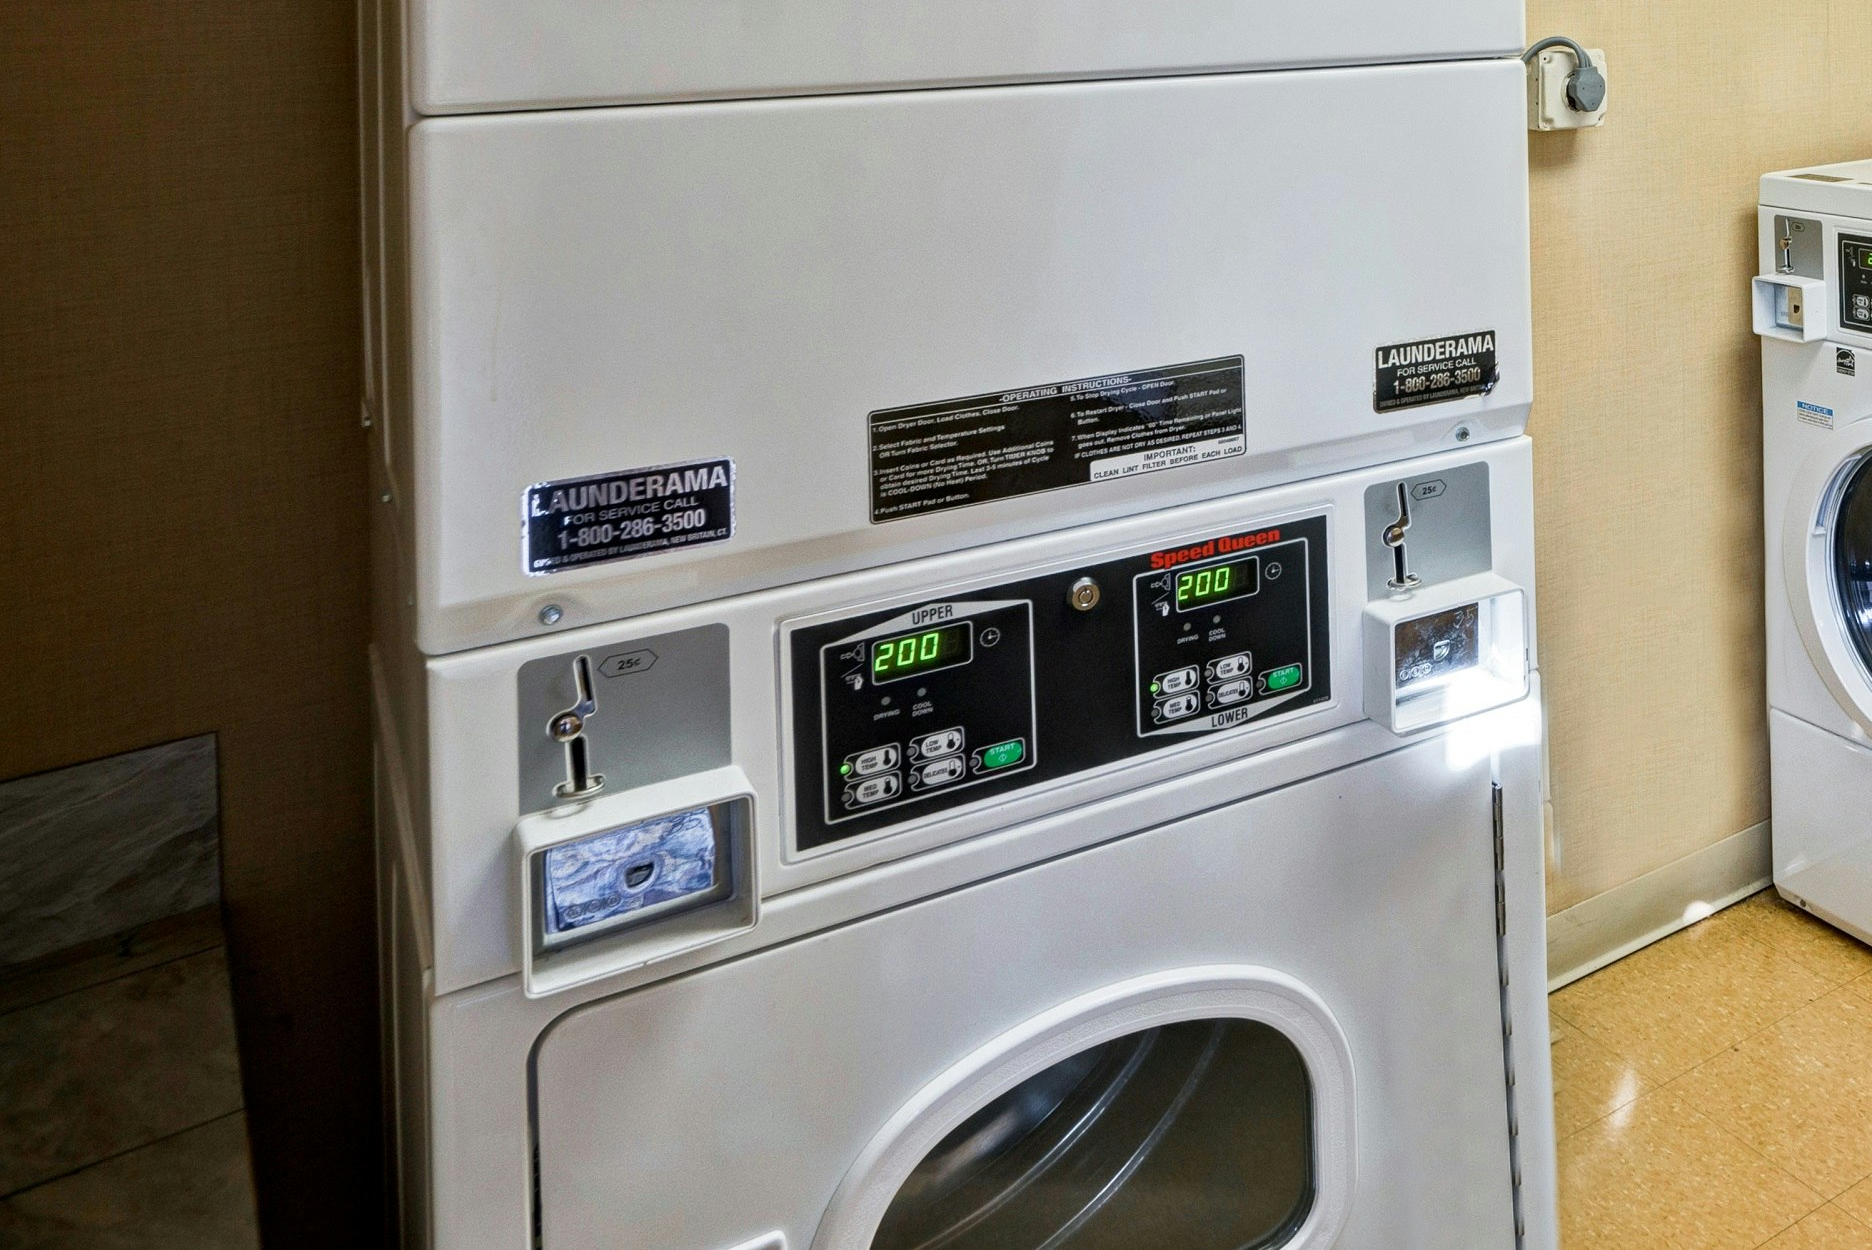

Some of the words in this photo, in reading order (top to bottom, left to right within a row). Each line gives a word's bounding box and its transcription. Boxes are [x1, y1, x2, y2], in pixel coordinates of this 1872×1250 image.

[1378, 334, 1494, 368] LAUNDERAMA
[1418, 361, 1454, 374] SERVICE
[1456, 358, 1476, 366] CALL
[1394, 367, 1480, 394] 1-800-286-3500
[1802, 403, 1827, 414] NOTICE
[901, 438, 921, 447] Fabric
[937, 429, 977, 441] Temperature
[979, 425, 1005, 434] Settings
[908, 446, 928, 454] Fabric
[1144, 446, 1196, 461] IMPORTANT:
[1094, 469, 1119, 479] CLEAN
[1123, 465, 1138, 473] LINT
[1142, 461, 1166, 469] FILTER
[1170, 455, 1198, 464] BEFORE
[1224, 446, 1242, 454] LOAD
[531, 466, 728, 517] LAUNDERAMA
[1422, 486, 1436, 494] 25¢
[563, 515, 595, 525] FOR
[599, 503, 659, 521] SERVICE
[664, 496, 699, 510] CALL
[899, 501, 921, 510] START
[558, 509, 706, 550] 1-800-286-3500
[1151, 540, 1214, 569] Speed
[1218, 529, 1280, 552] Queen
[1178, 567, 1230, 600] 200
[912, 605, 953, 625] UPPER
[1209, 628, 1225, 636] COOL
[1177, 634, 1199, 644] DRYING
[1209, 634, 1226, 642] DOWN
[875, 633, 939, 671] 200
[618, 658, 640, 670] 25¢
[1272, 668, 1294, 677] START
[1218, 689, 1238, 698] DELICATES
[913, 701, 932, 710] COOL
[874, 709, 900, 720] DRYING
[912, 707, 933, 717] DOWN
[1212, 708, 1248, 727] LOWER
[926, 745, 942, 753] TEMP
[990, 743, 1015, 755] START
[861, 756, 876, 764] HIGH
[862, 762, 878, 771] TEMP
[924, 768, 948, 779] DELICATES
[863, 790, 879, 798] TEMP
